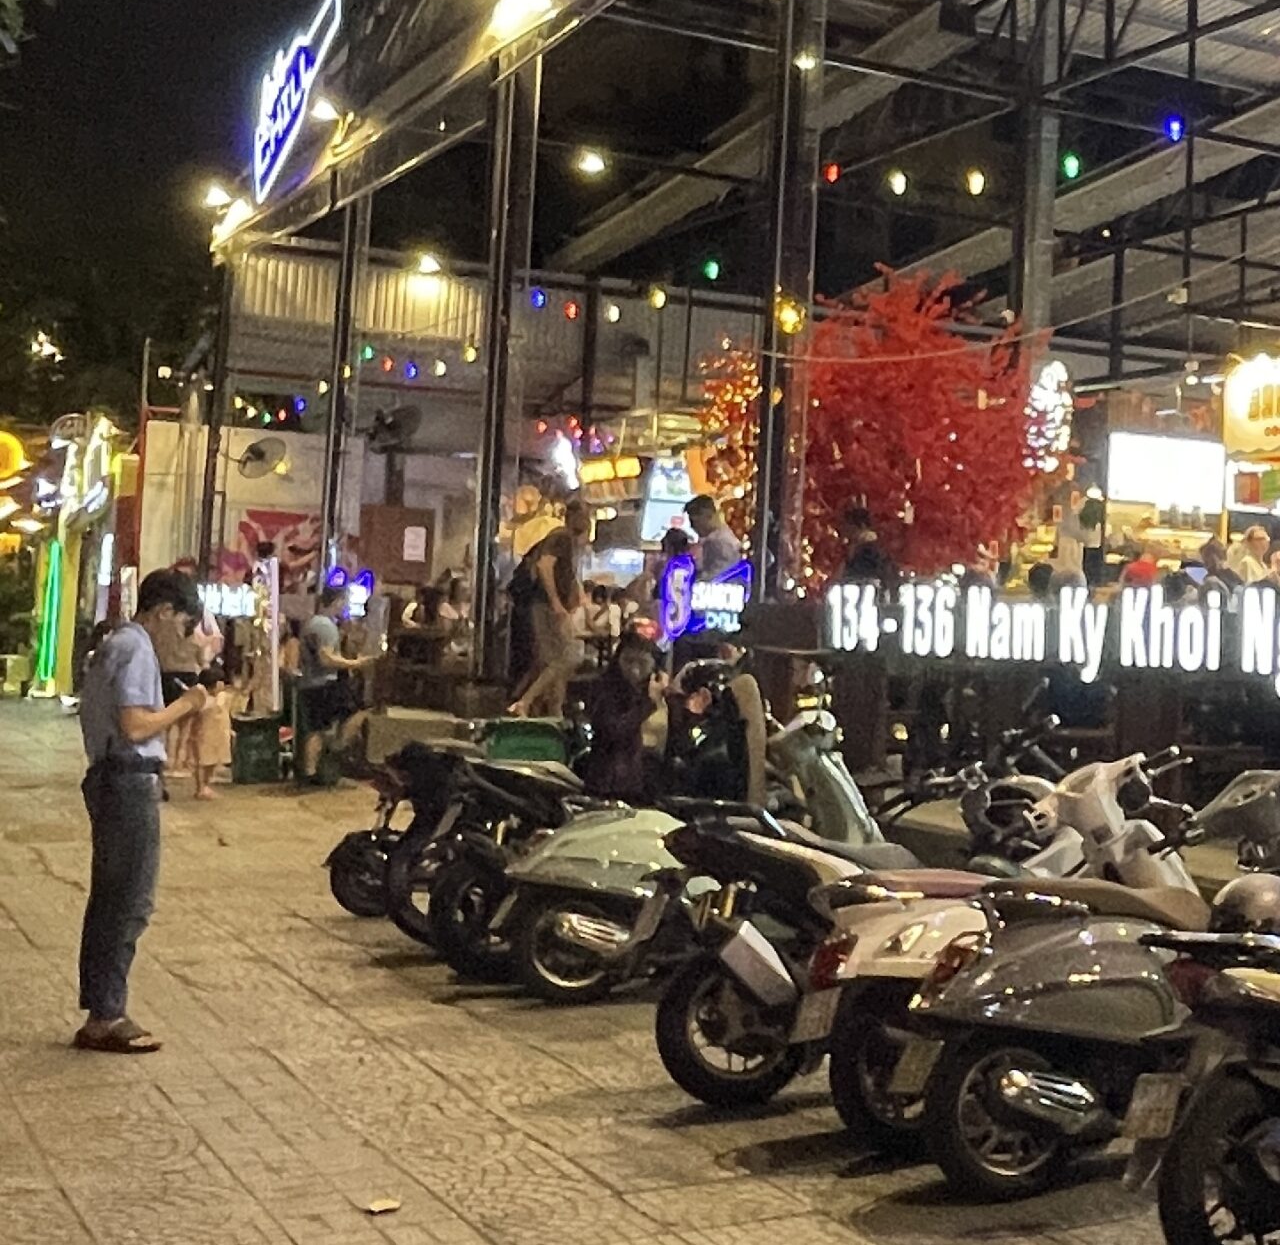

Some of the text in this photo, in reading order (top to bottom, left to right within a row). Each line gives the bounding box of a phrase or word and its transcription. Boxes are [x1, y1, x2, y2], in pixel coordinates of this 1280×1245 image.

[827, 582, 956, 657] 134-136
[966, 586, 1045, 661] Nam
[1059, 586, 1107, 683] Ky
[1119, 585, 1222, 671] Khoi
